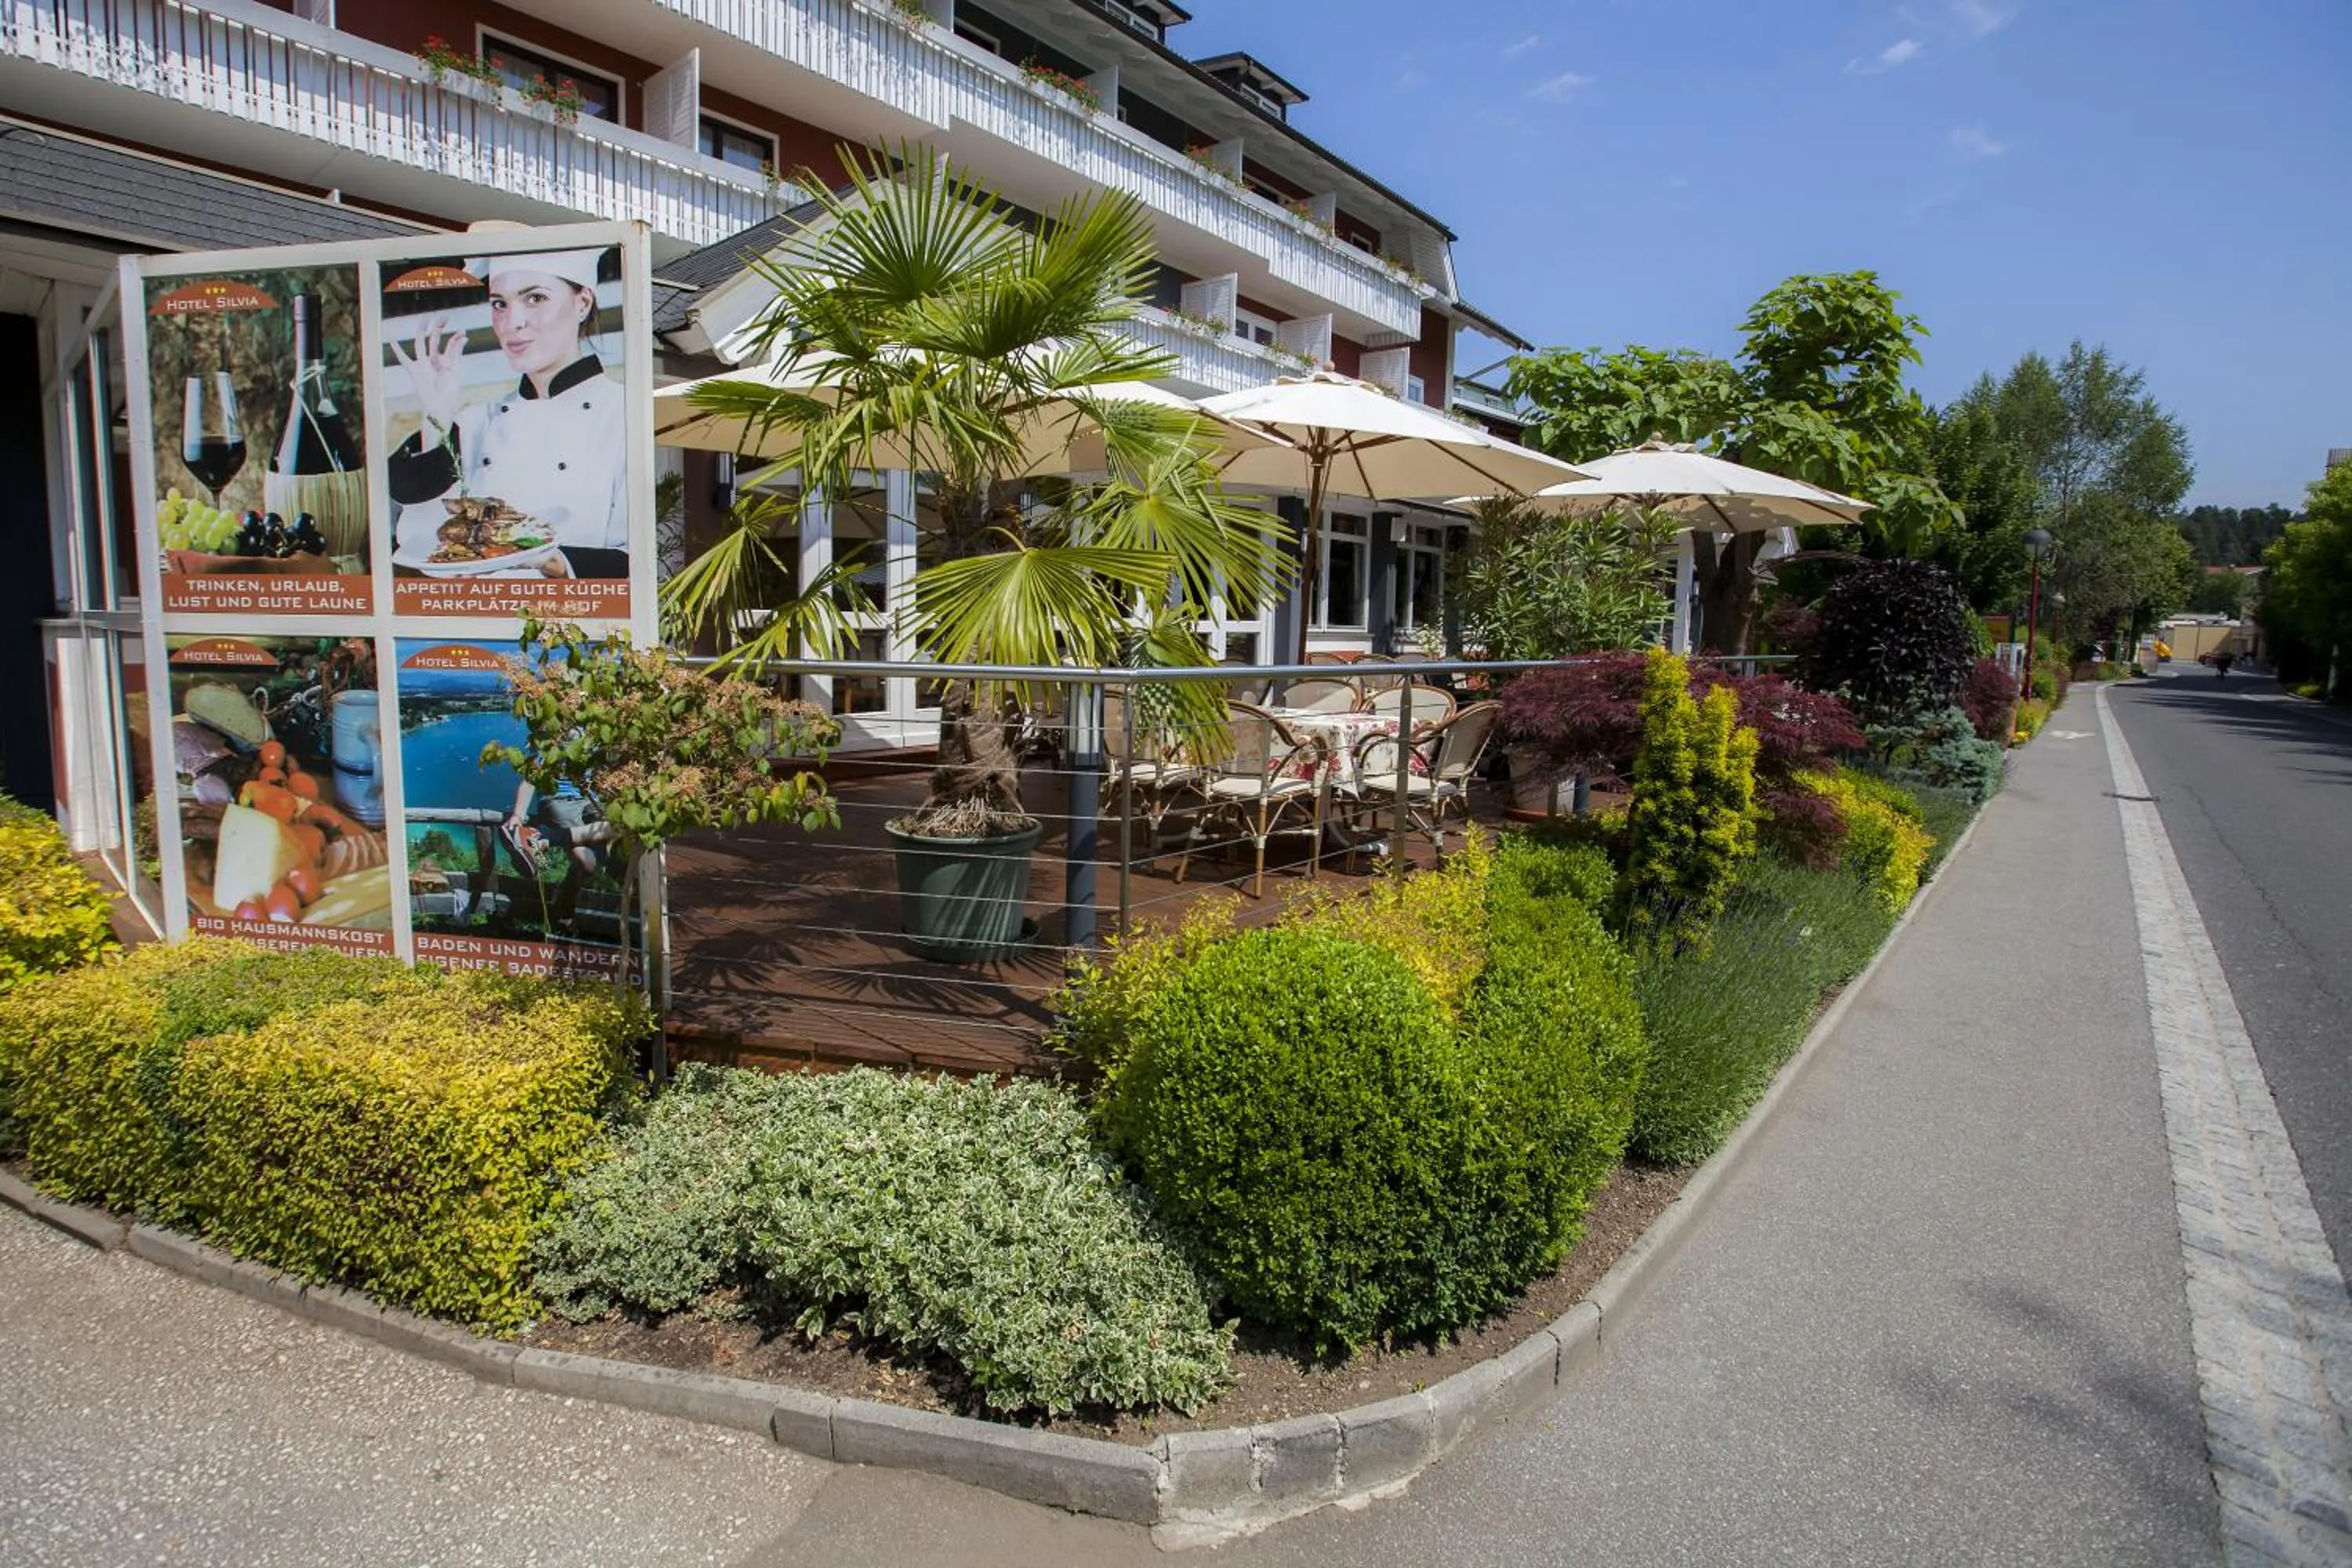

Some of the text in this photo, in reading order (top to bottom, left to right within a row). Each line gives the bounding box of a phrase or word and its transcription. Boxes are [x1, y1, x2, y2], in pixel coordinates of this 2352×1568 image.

[397, 277, 469, 289] HOTEL SILVIA
[166, 297, 259, 310] HOTEL SILVIA
[186, 579, 345, 593] TRINKEN, URLAUB,
[396, 581, 628, 595] APPETIT AUF GUTE KÜCHE
[169, 596, 367, 609] LUST UND GUTE LAUNE
[421, 597, 530, 611] PARKPLÄTZE
[183, 652, 263, 662] HOTEL SILVIA
[416, 657, 499, 667] HOTEL SILVIA
[197, 917, 225, 929] BIO
[231, 919, 385, 944] HAUSMANNSKOST
[417, 937, 481, 953] BADEN
[490, 943, 531, 957] UND
